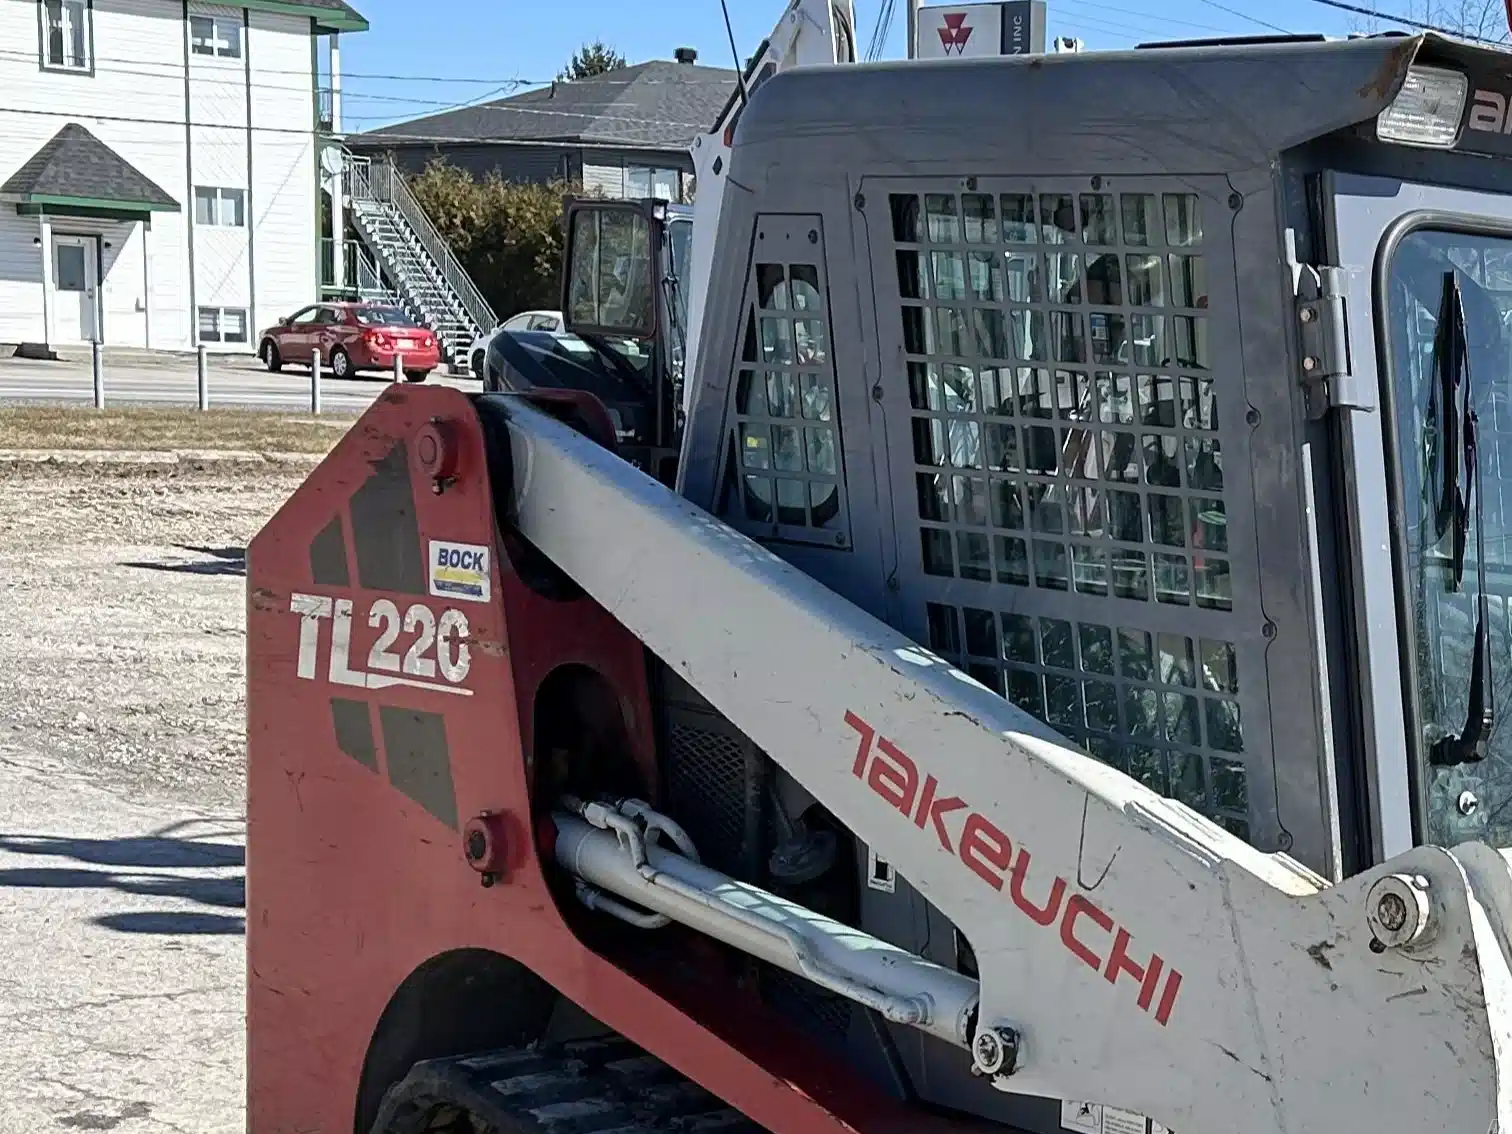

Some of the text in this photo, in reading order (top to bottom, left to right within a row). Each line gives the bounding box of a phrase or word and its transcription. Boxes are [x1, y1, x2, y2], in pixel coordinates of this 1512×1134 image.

[1014, 16, 1022, 41] INC
[437, 547, 484, 571] BOCK
[290, 592, 472, 690] TL220
